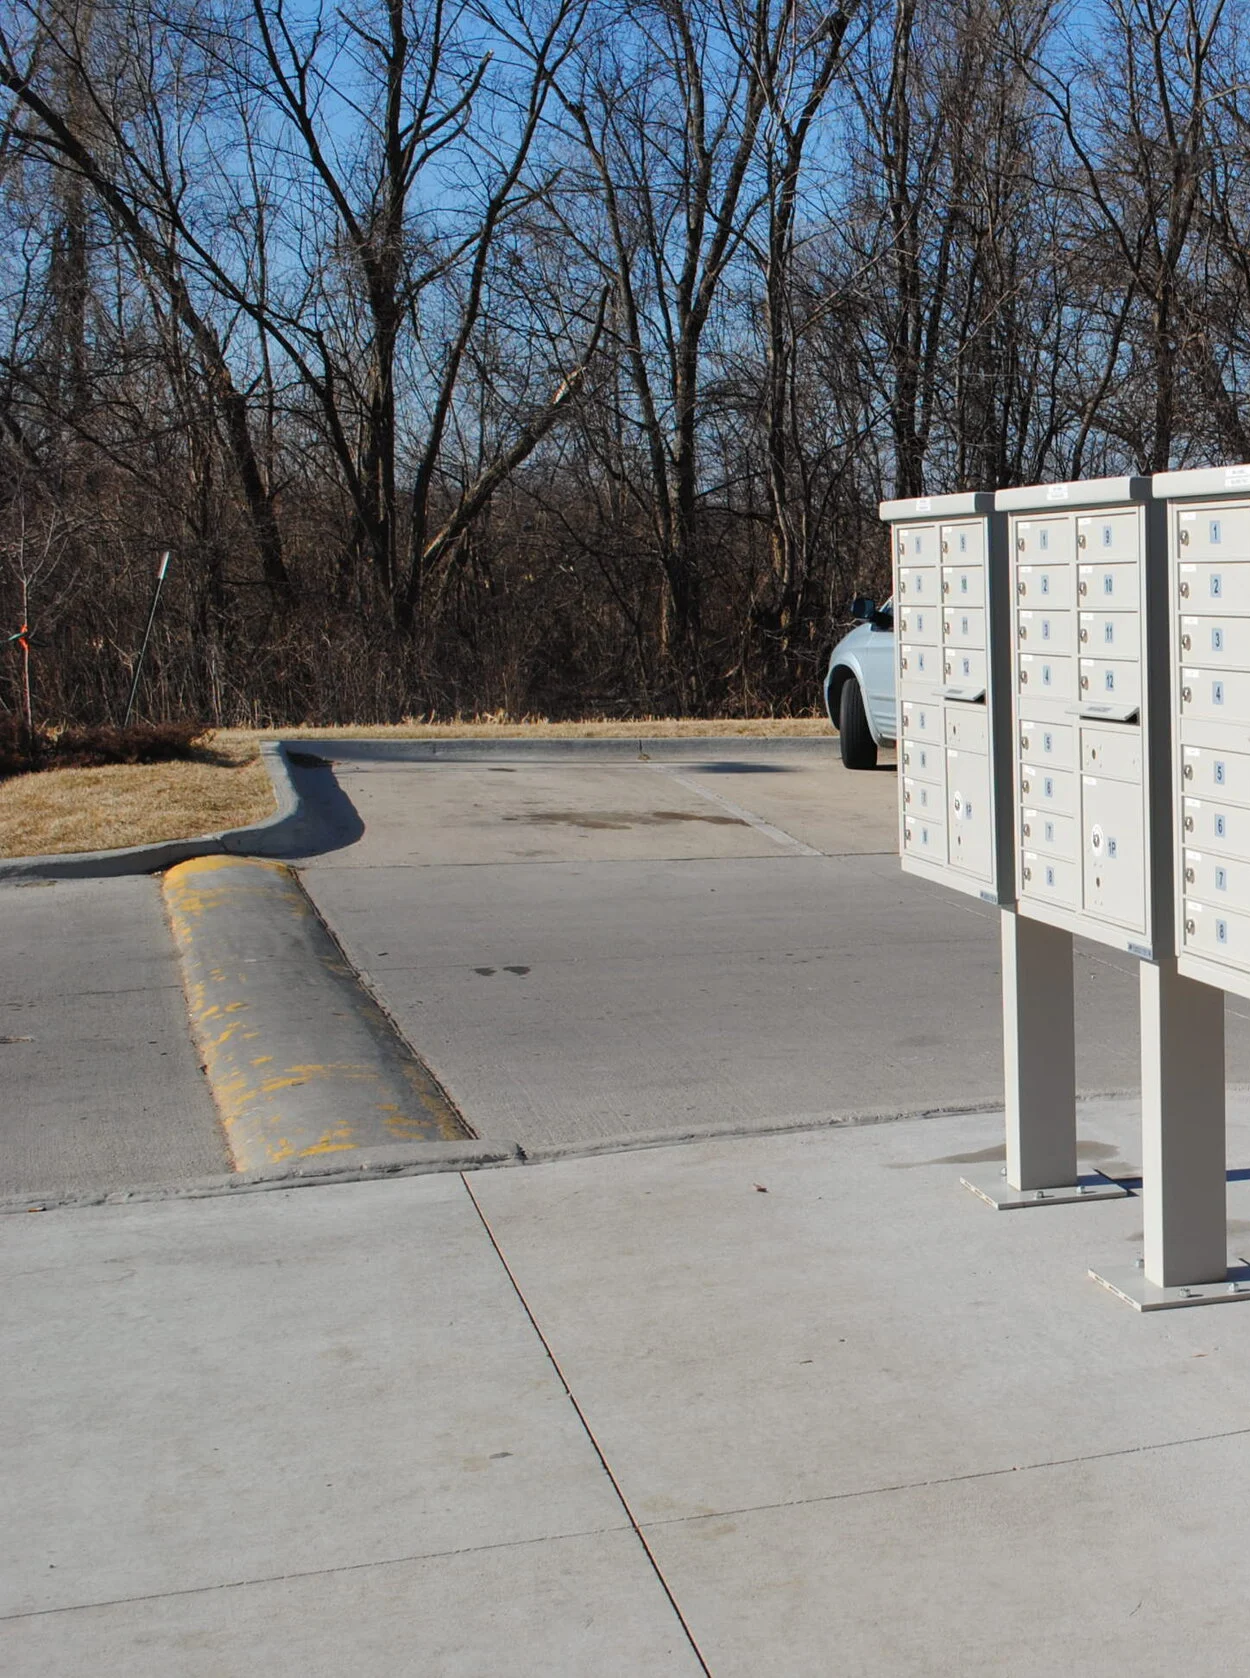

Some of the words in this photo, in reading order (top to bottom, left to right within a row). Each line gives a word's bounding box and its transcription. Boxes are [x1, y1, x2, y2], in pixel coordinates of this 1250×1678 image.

[1213, 579, 1219, 595] 2
[1215, 632, 1221, 648] 3
[1215, 687, 1222, 701] 4
[1216, 766, 1223, 781] 5
[1217, 819, 1223, 834] 6
[1218, 871, 1224, 886] 7
[1219, 924, 1225, 940] 8
